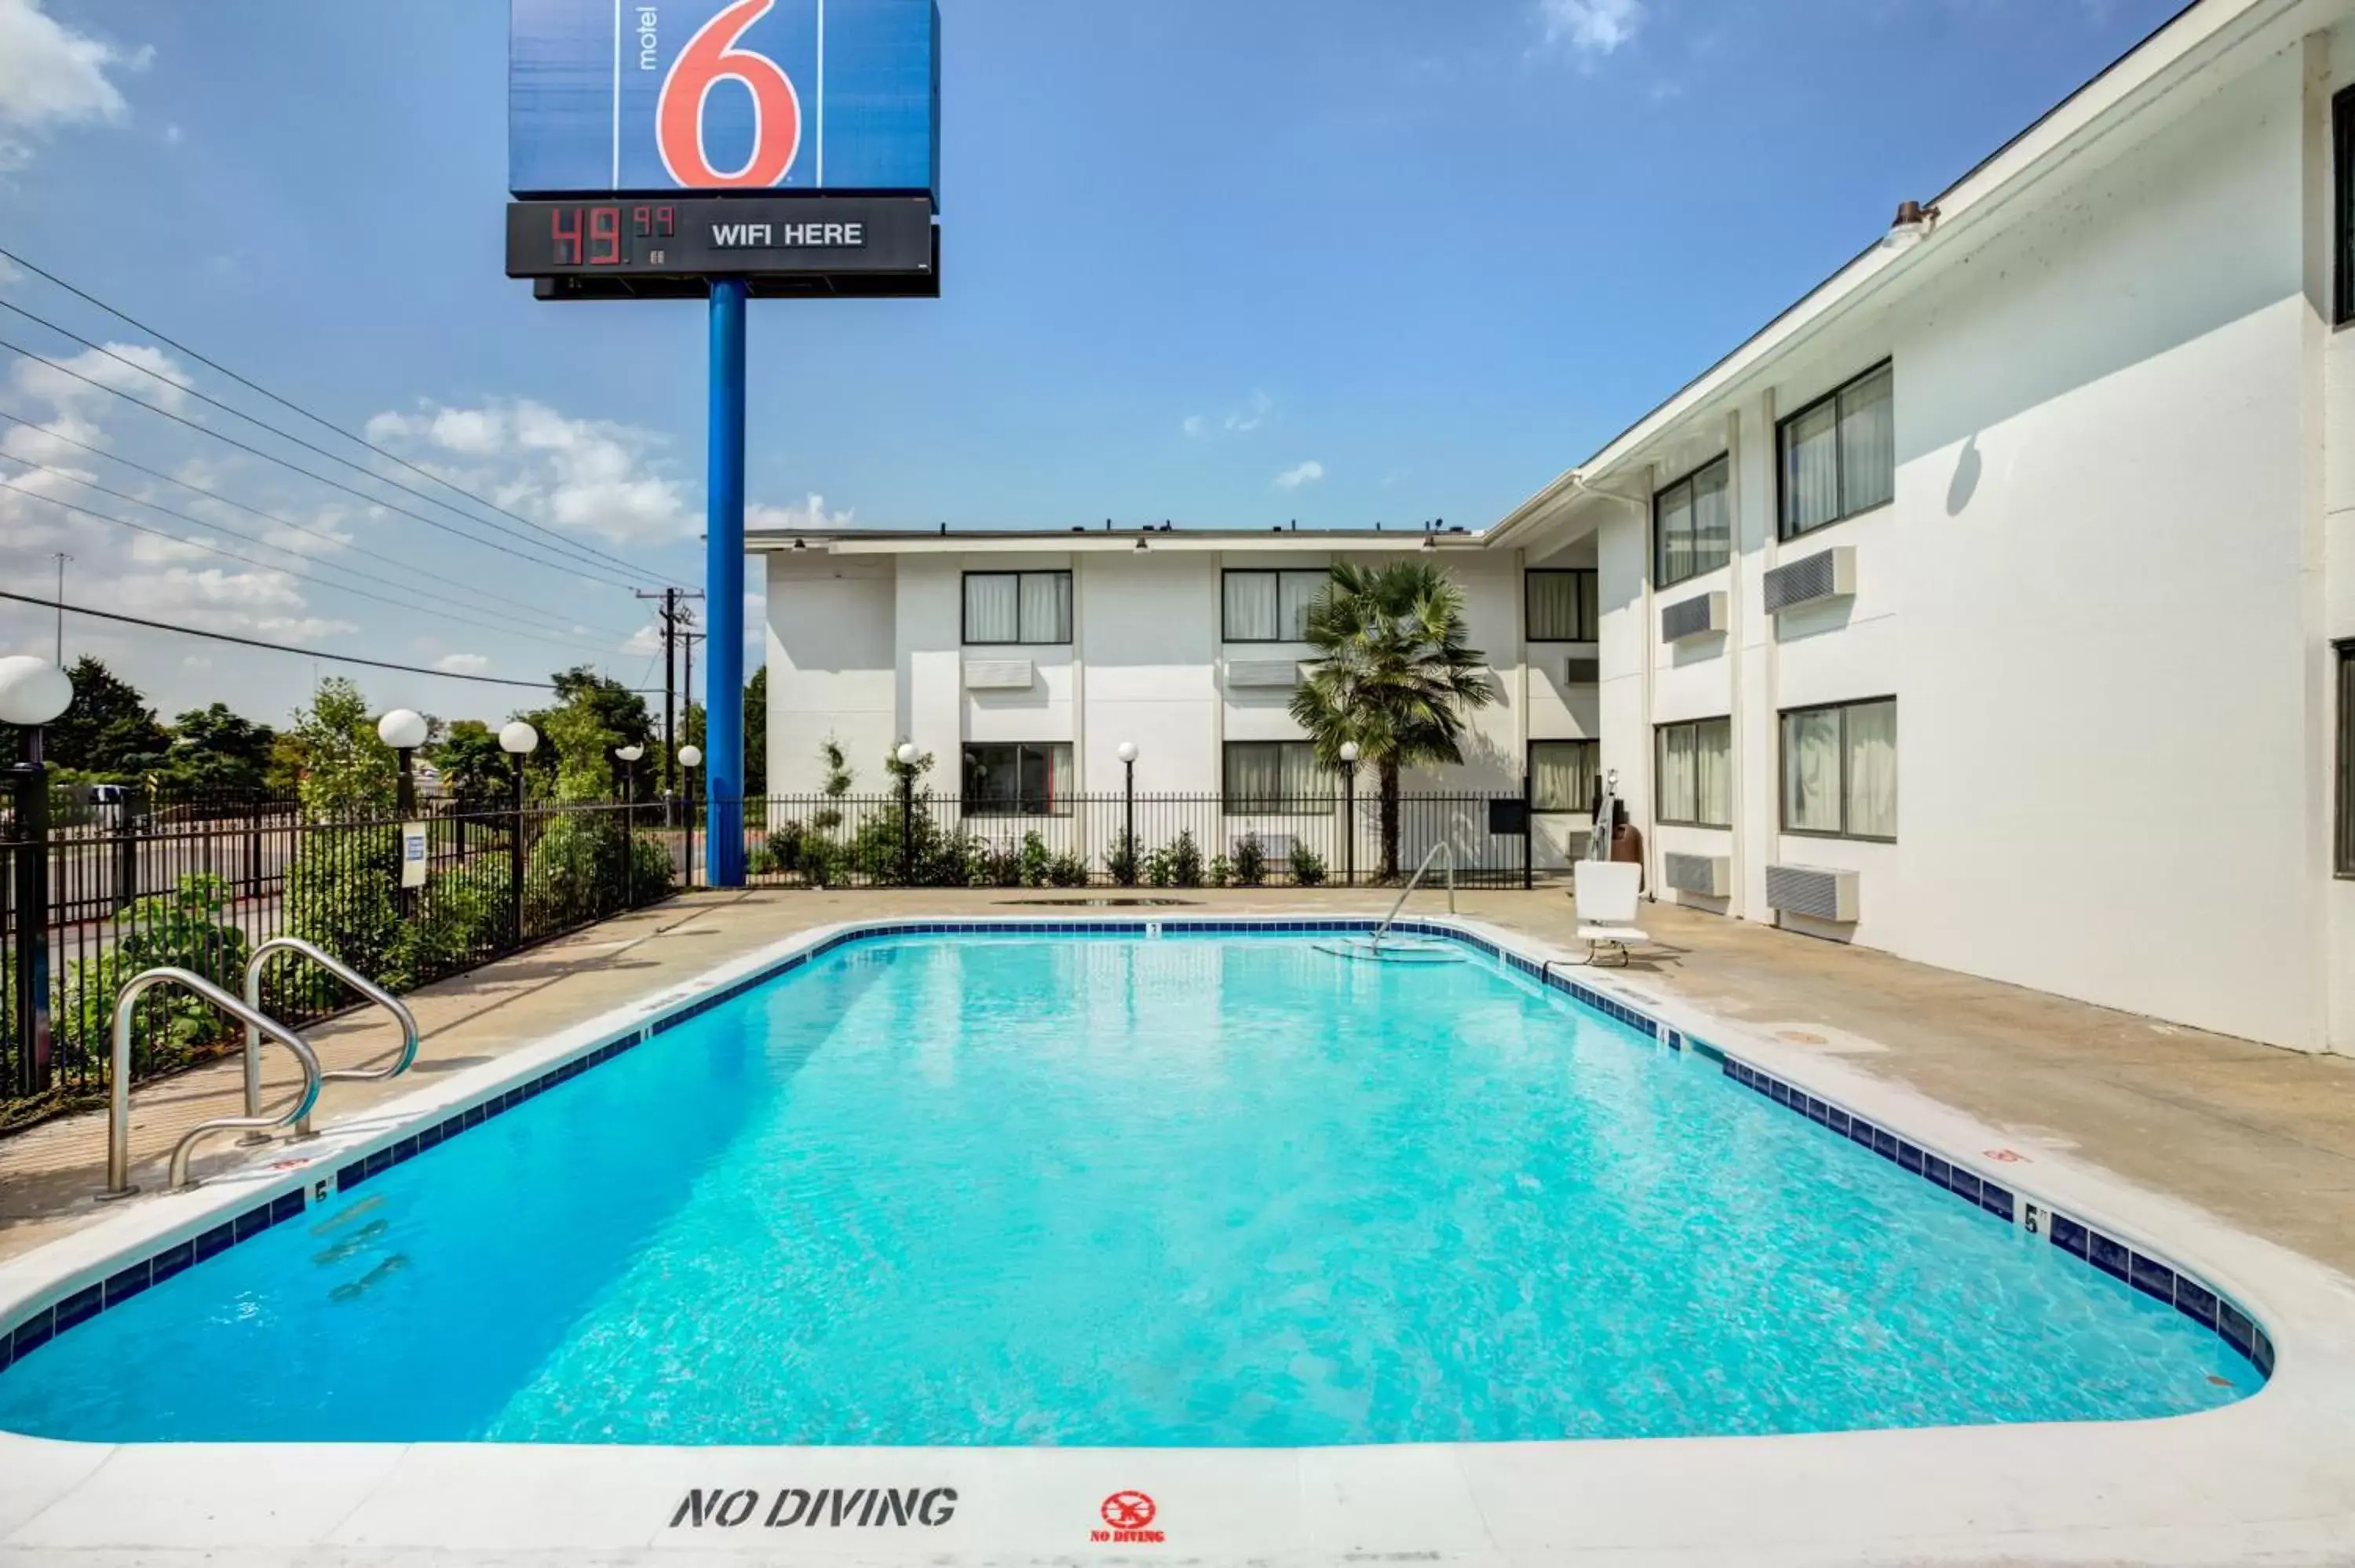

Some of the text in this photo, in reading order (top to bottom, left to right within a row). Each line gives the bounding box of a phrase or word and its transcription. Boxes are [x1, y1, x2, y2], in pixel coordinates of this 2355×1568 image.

[635, 6, 659, 70] motel
[655, 0, 801, 187] 6
[712, 223, 862, 246] WIFI HERE
[315, 1180, 327, 1203] 5
[2025, 1202, 2038, 1234] 5
[670, 1487, 958, 1527] NO DIVING
[1090, 1530, 1165, 1542] NO DIVING
